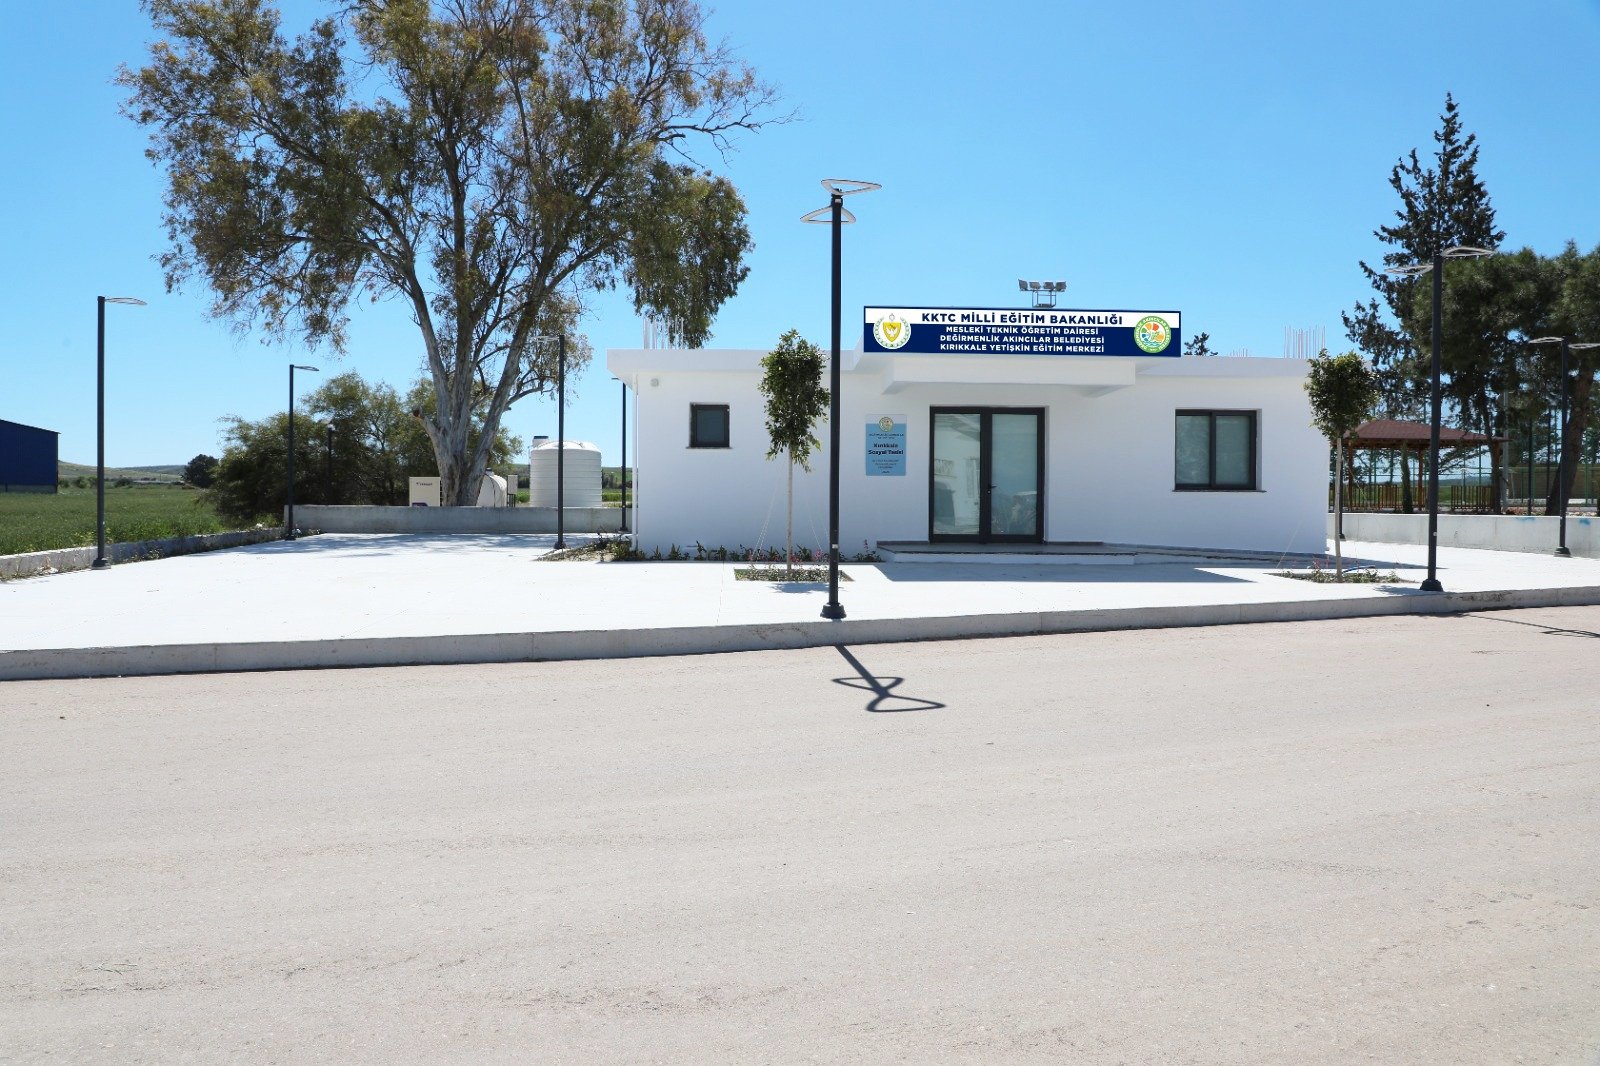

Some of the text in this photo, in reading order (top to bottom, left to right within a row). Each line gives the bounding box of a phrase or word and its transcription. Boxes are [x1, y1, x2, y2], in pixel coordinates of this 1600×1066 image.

[922, 312, 1122, 325] KKTC MİLLİ EĞİTİM BAKANLIĞI
[940, 334, 999, 342] DEĞİRMENLİK
[990, 344, 1030, 352] YETİŞKİN
